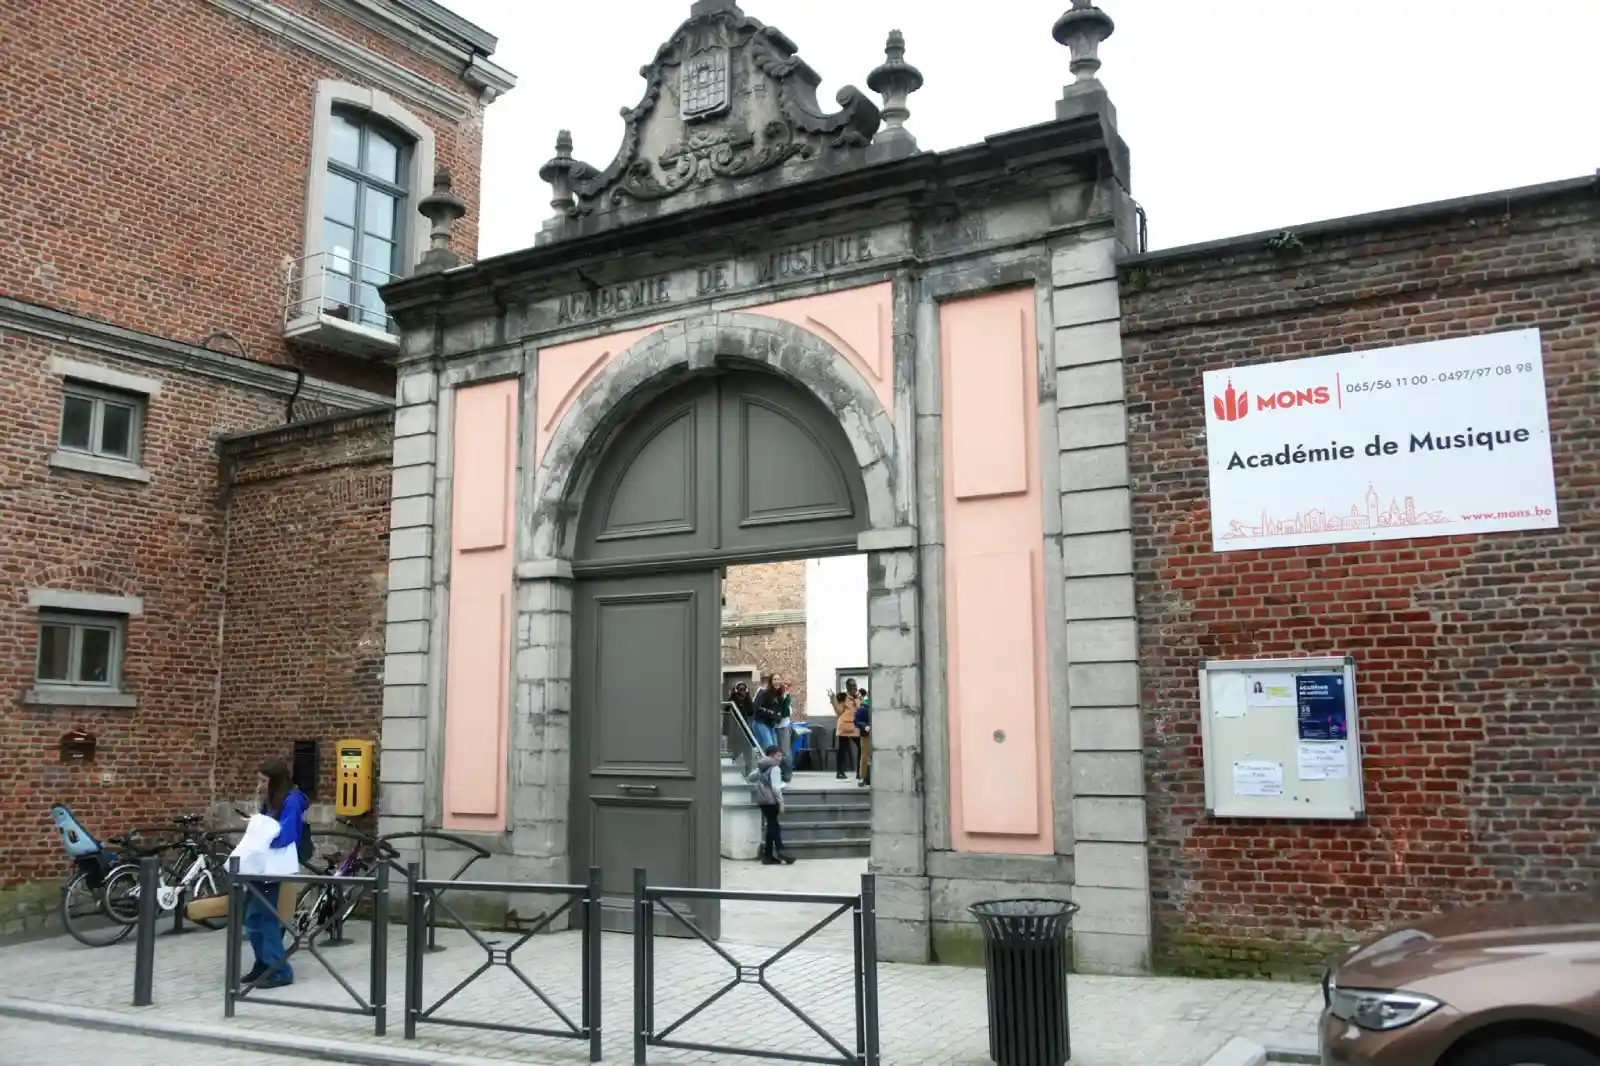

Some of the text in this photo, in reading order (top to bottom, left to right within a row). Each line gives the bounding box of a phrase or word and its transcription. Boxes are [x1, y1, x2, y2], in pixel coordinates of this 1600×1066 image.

[698, 263, 729, 293] DE
[757, 232, 874, 284] MUSIQUE
[1346, 379, 1392, 393] 065/56
[1396, 377, 1408, 388] 11
[1411, 374, 1428, 386] 00
[1438, 366, 1492, 382] 0497/97
[1495, 364, 1512, 376] 08
[1516, 362, 1533, 373] 98
[1257, 385, 1331, 411] MONS
[1226, 426, 1530, 470] Académie de Musique
[1461, 506, 1552, 521] www.mons.be
